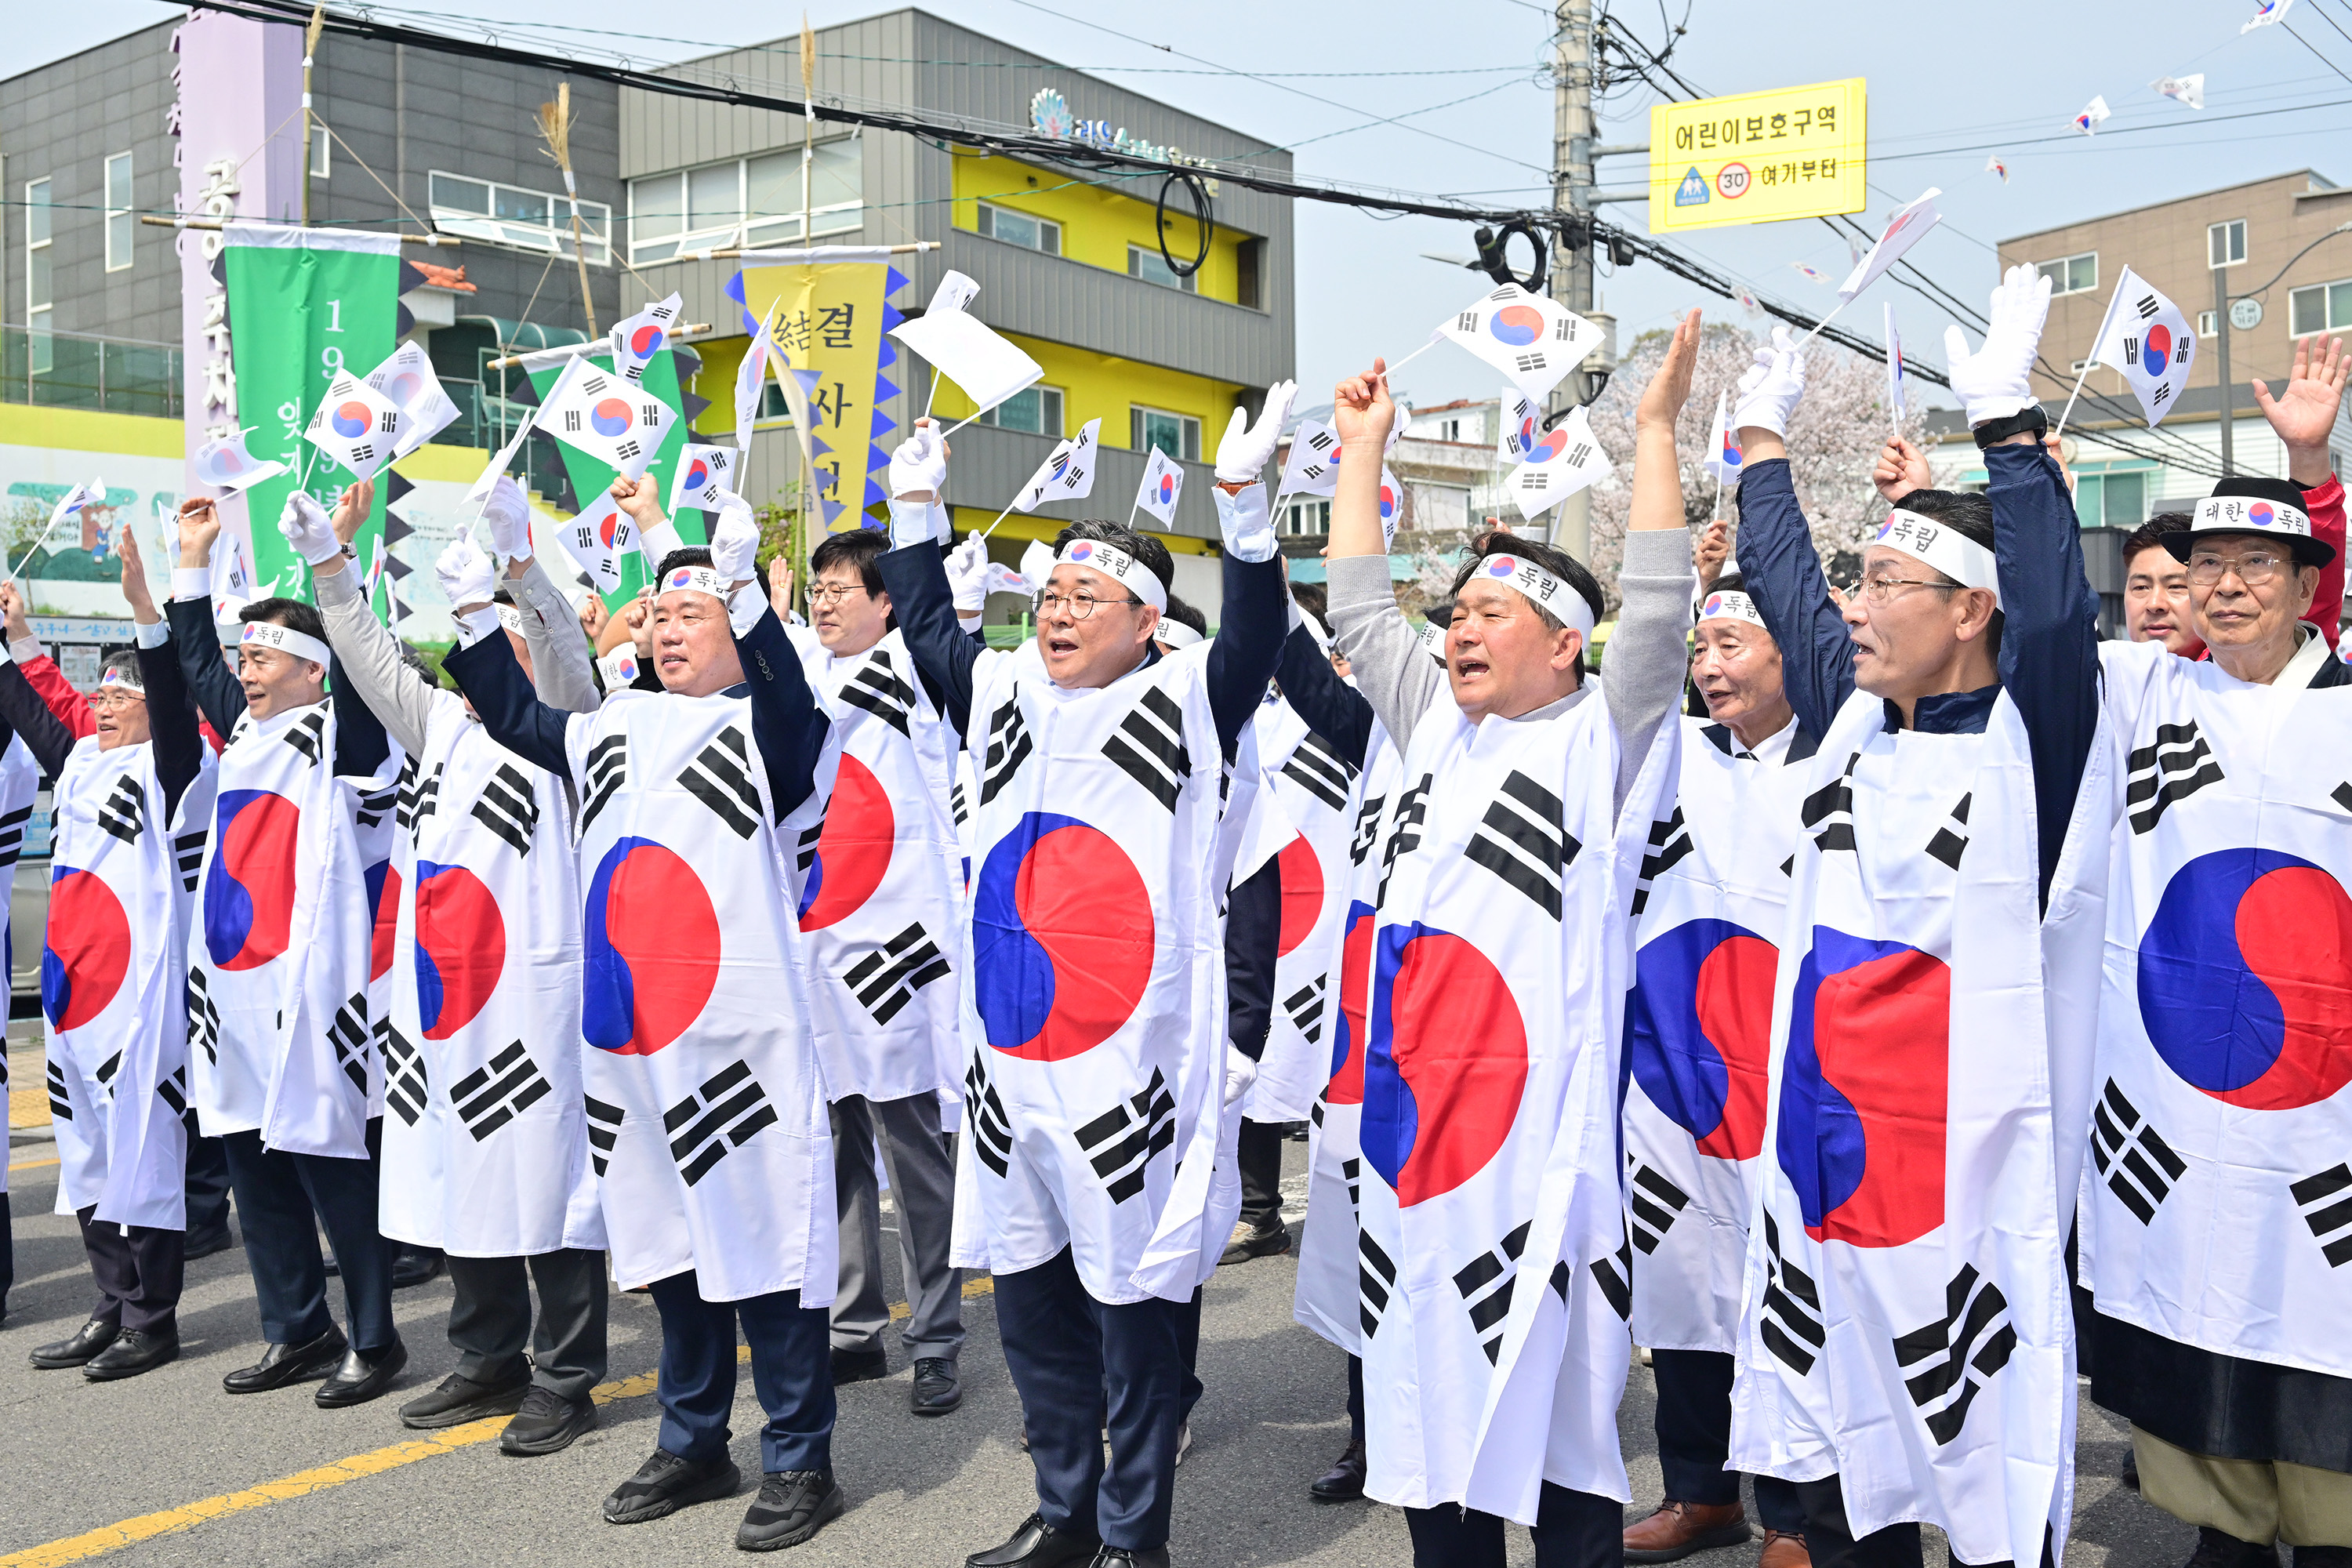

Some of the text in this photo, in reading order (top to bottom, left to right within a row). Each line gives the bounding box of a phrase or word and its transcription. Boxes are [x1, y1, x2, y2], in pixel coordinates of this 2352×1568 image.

[1676, 106, 1835, 150] 어린이보호구역
[1724, 158, 1836, 189] 30 여기부터
[278, 397, 303, 485] 잊지
[2206, 502, 2304, 535] 대한 독립
[1894, 517, 1939, 554] 독립
[1095, 548, 1131, 578] 독립
[1517, 566, 1559, 601] 독립
[497, 608, 521, 629] 독립
[256, 626, 284, 645] 독립
